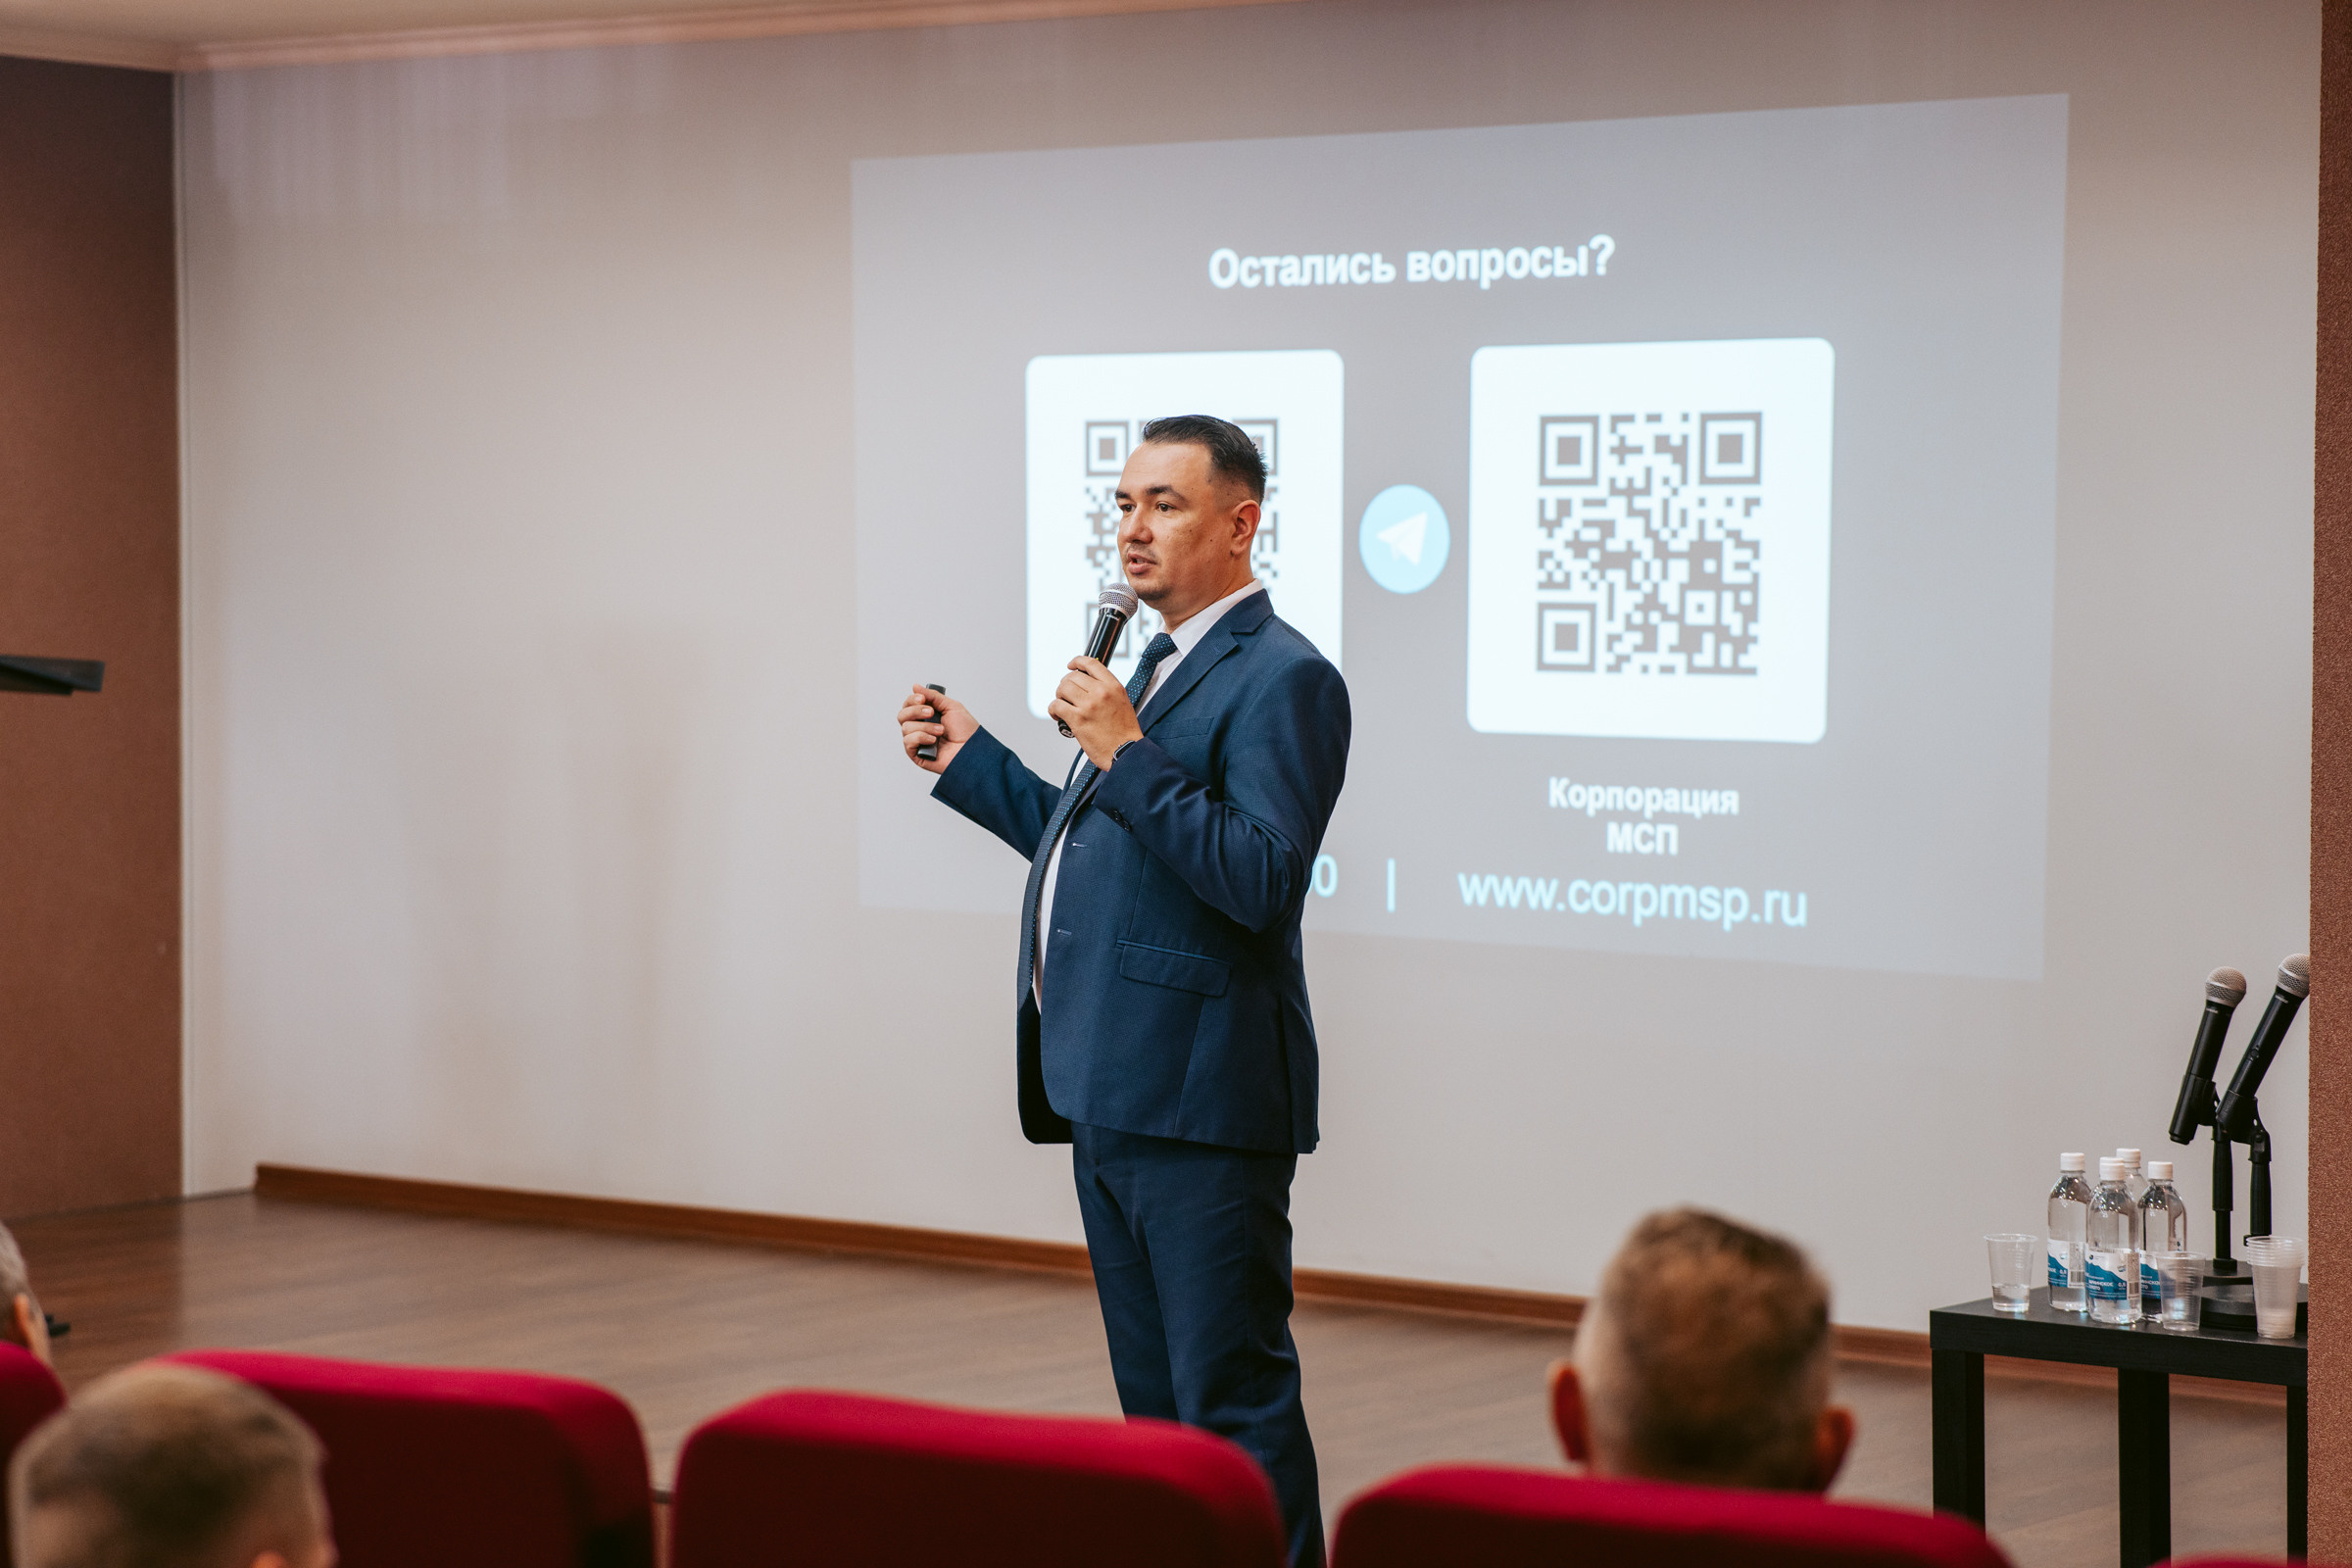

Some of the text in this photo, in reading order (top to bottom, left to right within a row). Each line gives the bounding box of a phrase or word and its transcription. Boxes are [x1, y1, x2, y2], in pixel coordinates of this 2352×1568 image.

[1208, 233, 1616, 290] Остались вопросы?
[1548, 776, 1740, 818] Корпорация
[1606, 821, 1679, 856] МСП
[1306, 853, 1338, 899] 0
[1457, 872, 1807, 932] www.corpmsp.ru
